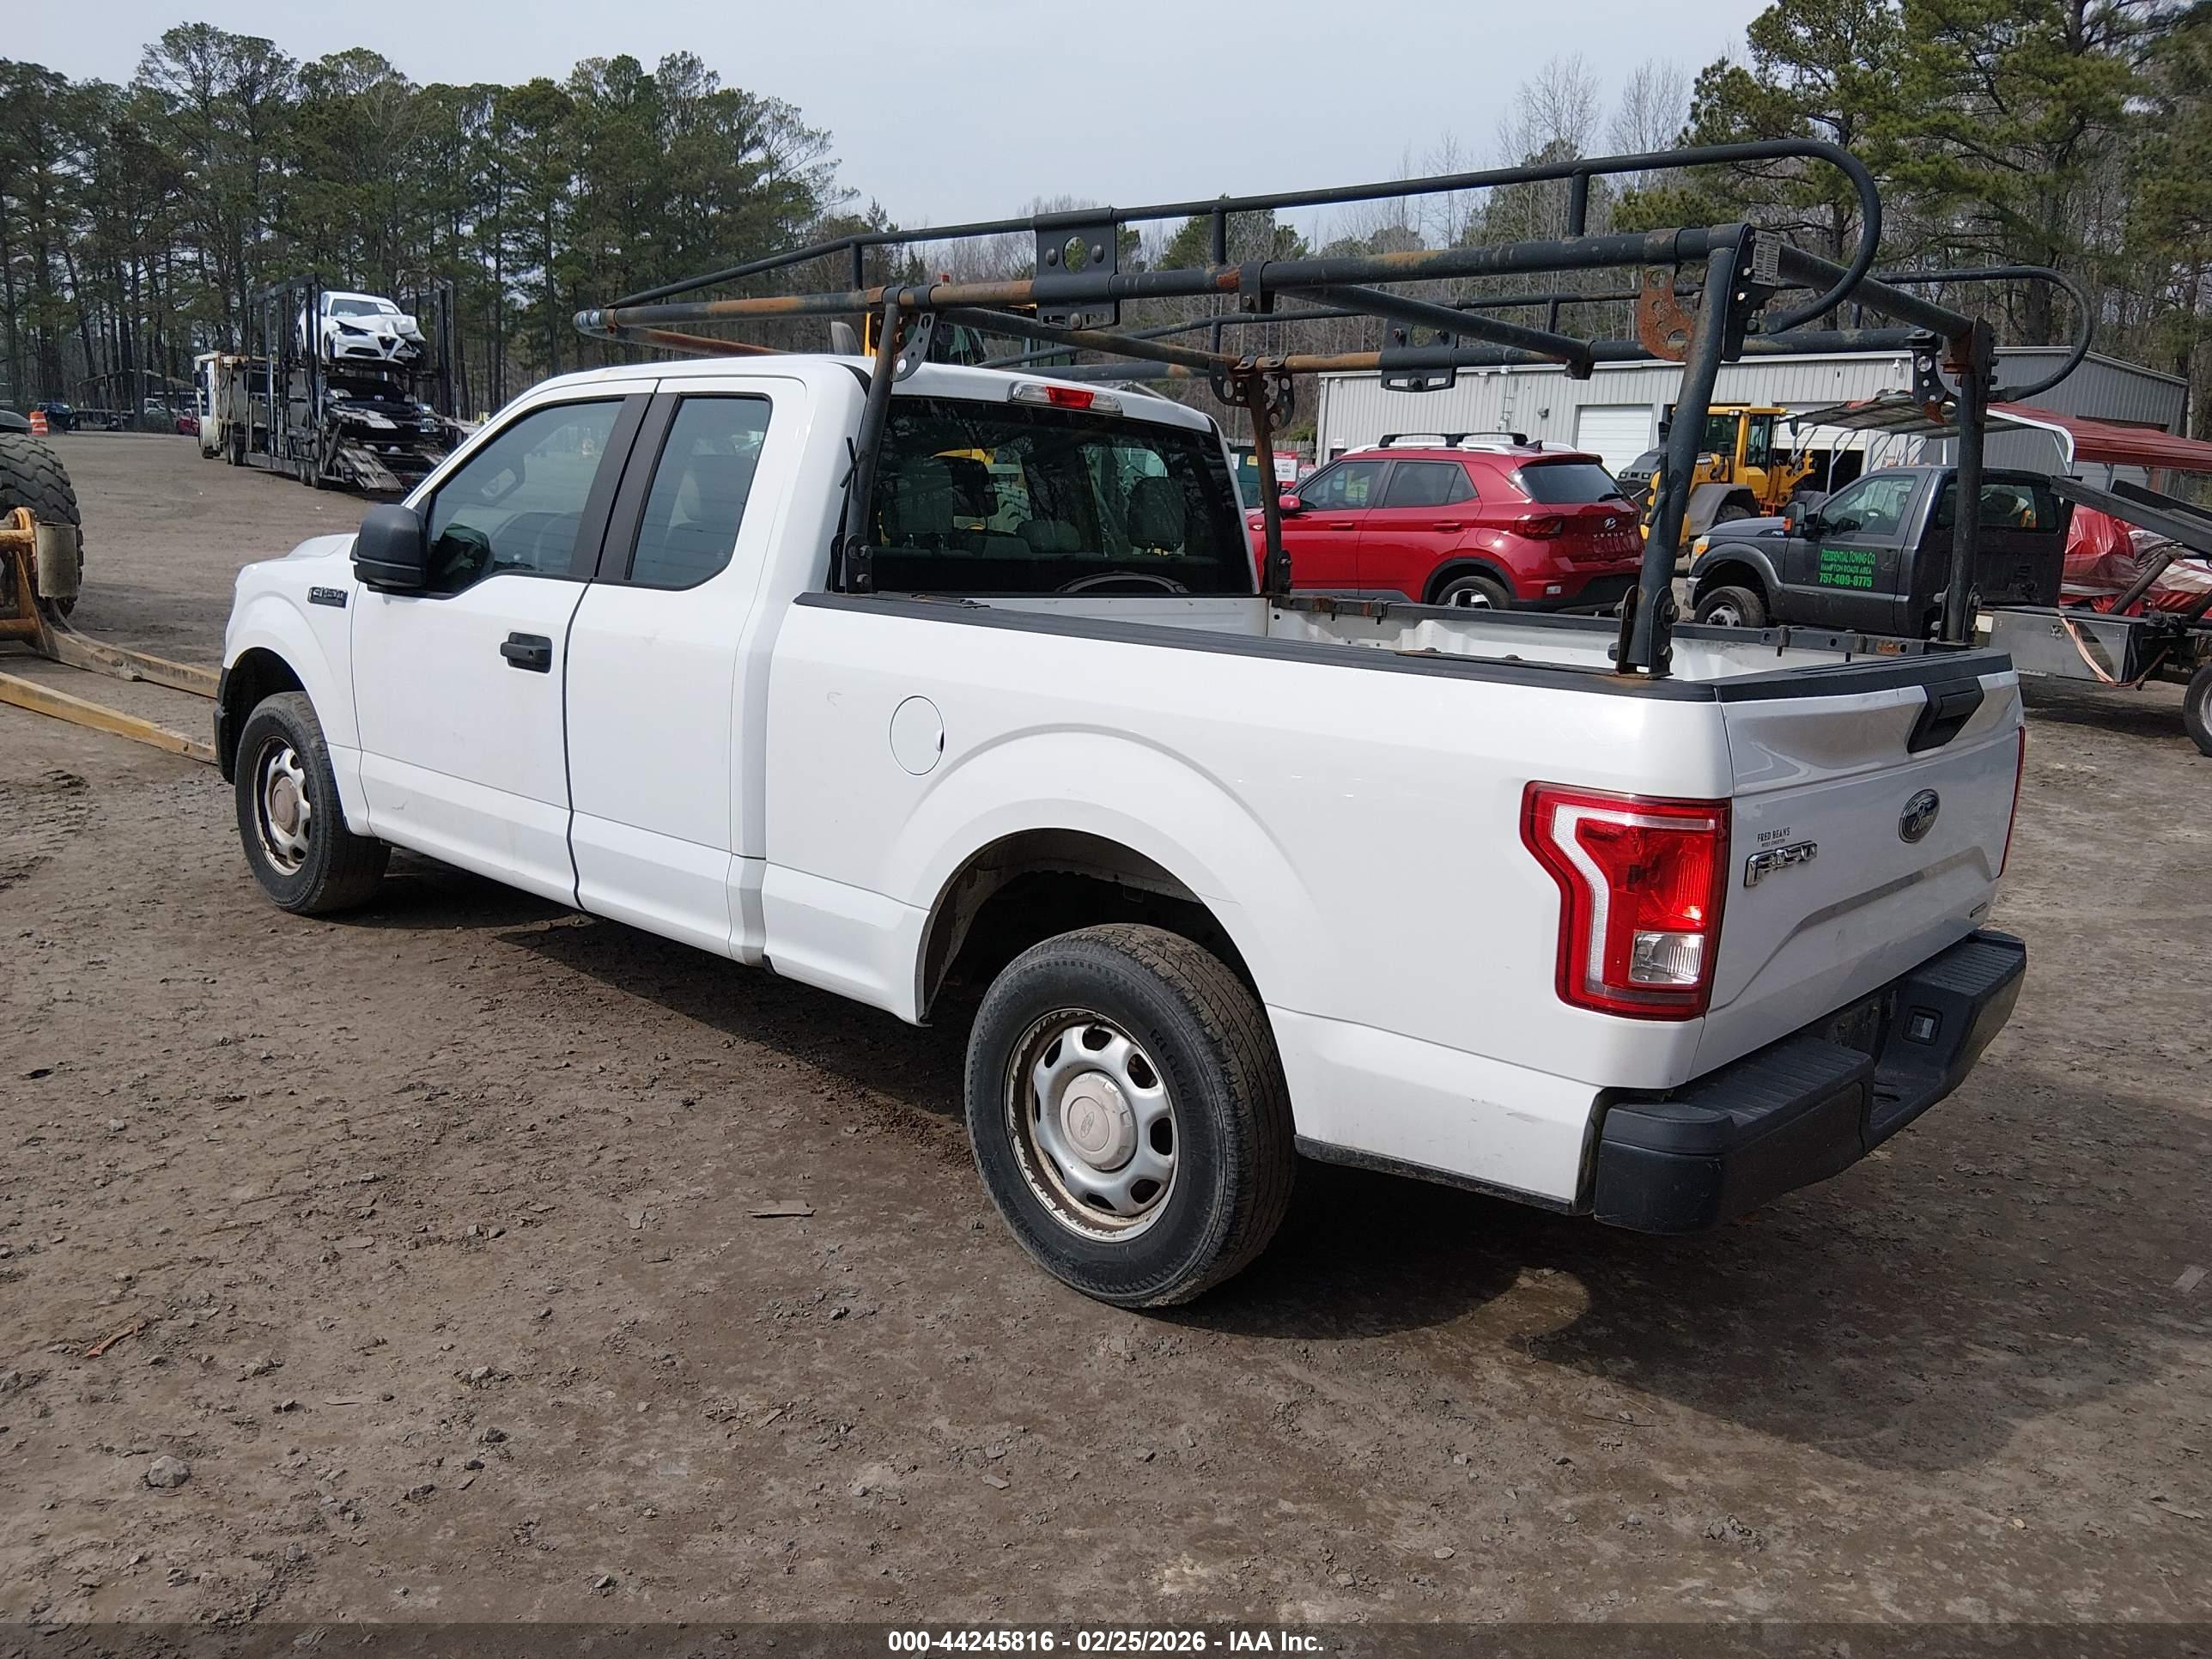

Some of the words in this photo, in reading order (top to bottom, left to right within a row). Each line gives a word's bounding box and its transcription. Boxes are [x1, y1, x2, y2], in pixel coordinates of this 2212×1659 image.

[1849, 550, 1867, 564] TOWING
[1820, 562, 1844, 573] HAMPTON
[1859, 566, 1872, 574] AREA
[1757, 831, 1771, 843] FRED
[1772, 827, 1790, 839] BEANS
